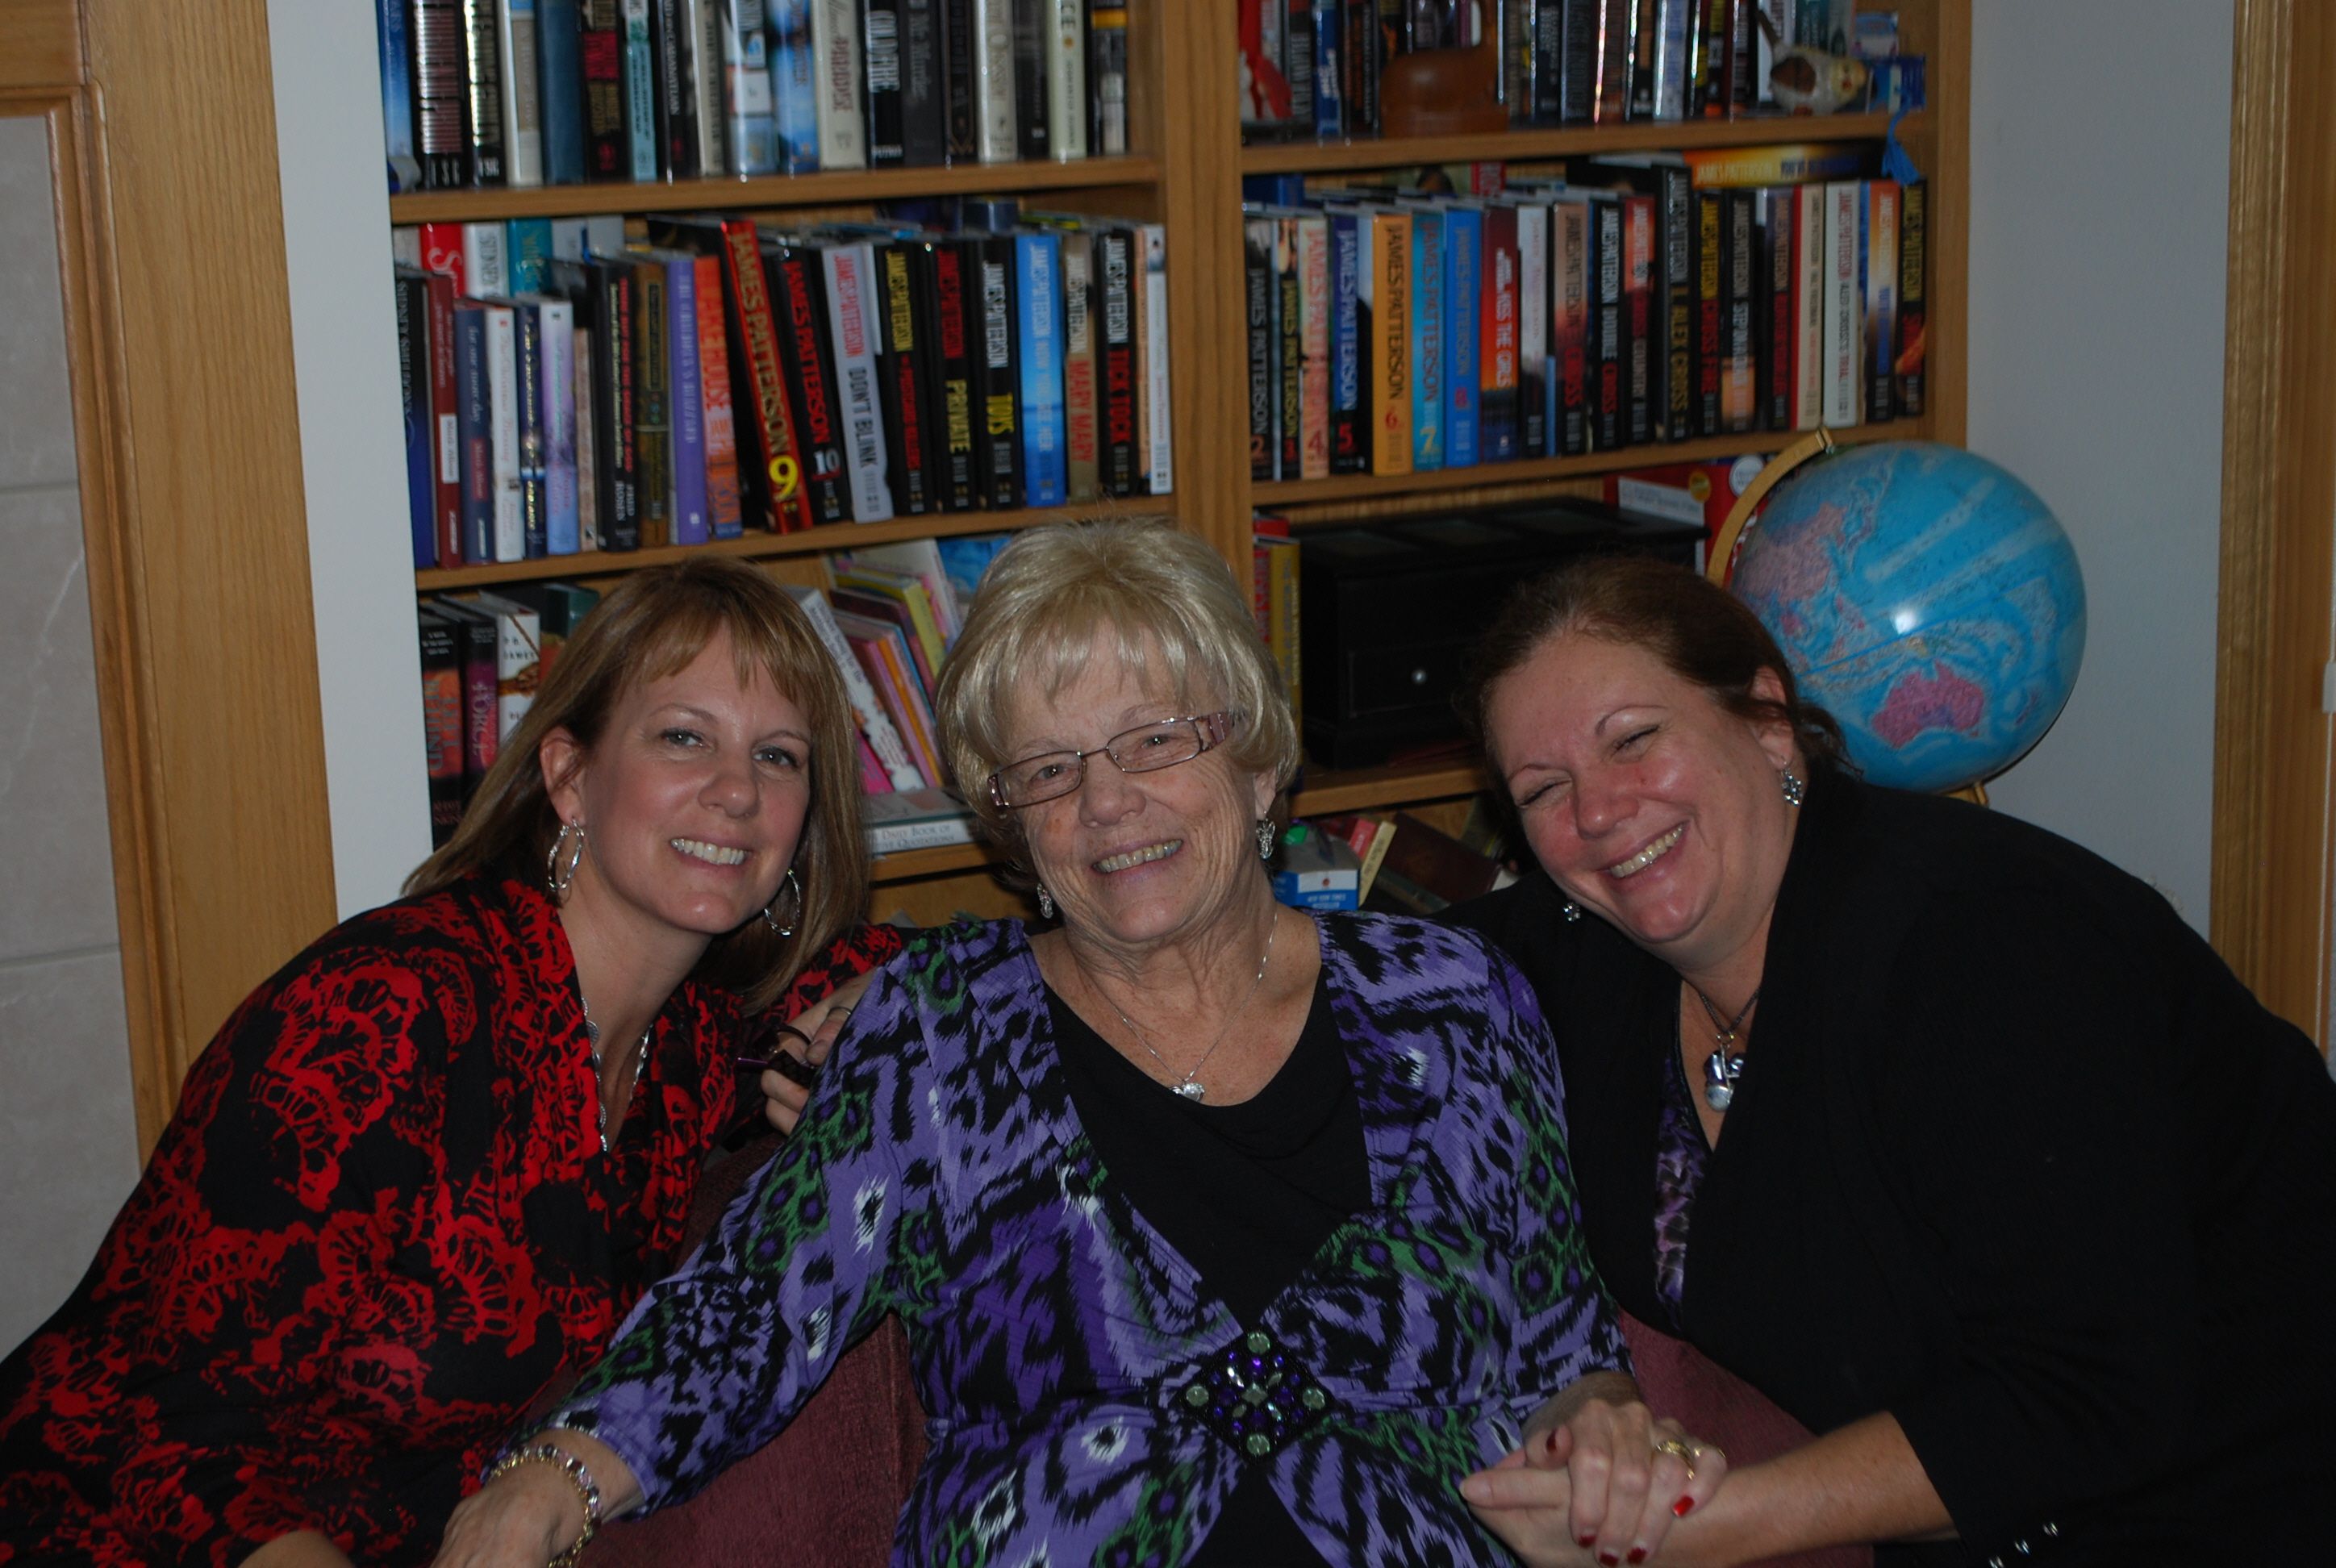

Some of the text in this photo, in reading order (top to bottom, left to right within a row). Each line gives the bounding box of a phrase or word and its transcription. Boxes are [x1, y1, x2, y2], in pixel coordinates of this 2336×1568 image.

[665, 35, 680, 115] CABANATUAN
[1633, 206, 1648, 236] JAMES
[1733, 200, 1749, 235] JAMES
[1774, 198, 1788, 227] JAMES
[1838, 193, 1852, 224] JAMES
[1838, 225, 1853, 281] PATTERSON
[1879, 194, 1893, 226] JAMES
[1902, 186, 1923, 302] JAMES PATTERSON
[885, 251, 913, 352] JAMES PATTERSON
[936, 249, 965, 360] JAMES PATTERSON
[1031, 244, 1049, 280] JAMES
[1454, 227, 1471, 377] JAMES PATTERSON
[1668, 171, 1689, 411] JAMES PATTERSON ALEX CROSS
[1700, 199, 1719, 395] JAMES PATTERSON CROSS FIRE
[1733, 236, 1750, 298] PATTERSON
[1774, 227, 1789, 291] PATTERSON
[729, 231, 790, 454] JAMES PATTERSON
[834, 255, 865, 357] JAMES PATTERSON
[982, 261, 1009, 369] JAMES PATTERSON
[1032, 281, 1052, 338] PATTERSON
[1104, 237, 1131, 445] JAMES PATTERSON TICK TOCK
[1248, 268, 1269, 435] JAMES PATTERSON
[1306, 229, 1328, 429] JAMES PATTERSON
[1337, 230, 1358, 411] JAMES PATTERSON
[1385, 225, 1404, 401] JAMES PATTERSON
[1416, 222, 1440, 402] JAMES PATTERSON
[1495, 291, 1513, 388] KISS THE GIRLS
[1565, 215, 1583, 407] JAMES PATTERSON CROSS
[1601, 207, 1619, 414] JAMES PATTERSON DOUBLE CROSS
[782, 261, 830, 444] JAMES PATTERSON
[1066, 255, 1094, 463] JAMES PATTERSON MARY MARY
[1282, 279, 1299, 438] JAMES PATTERSON
[1633, 339, 1647, 398] COUNTRY
[470, 401, 483, 424] day
[849, 367, 878, 469] DON'T BLINK
[945, 379, 971, 453] PRIVATE
[985, 392, 1015, 436] TOYS
[1337, 421, 1354, 457] 5
[1385, 411, 1398, 431] 6
[1419, 427, 1440, 457] 7
[615, 481, 626, 522] ROSEN
[767, 454, 799, 502] 9
[814, 448, 841, 474] 10
[423, 680, 443, 771] BEHIND
[471, 682, 490, 757] FORCE
